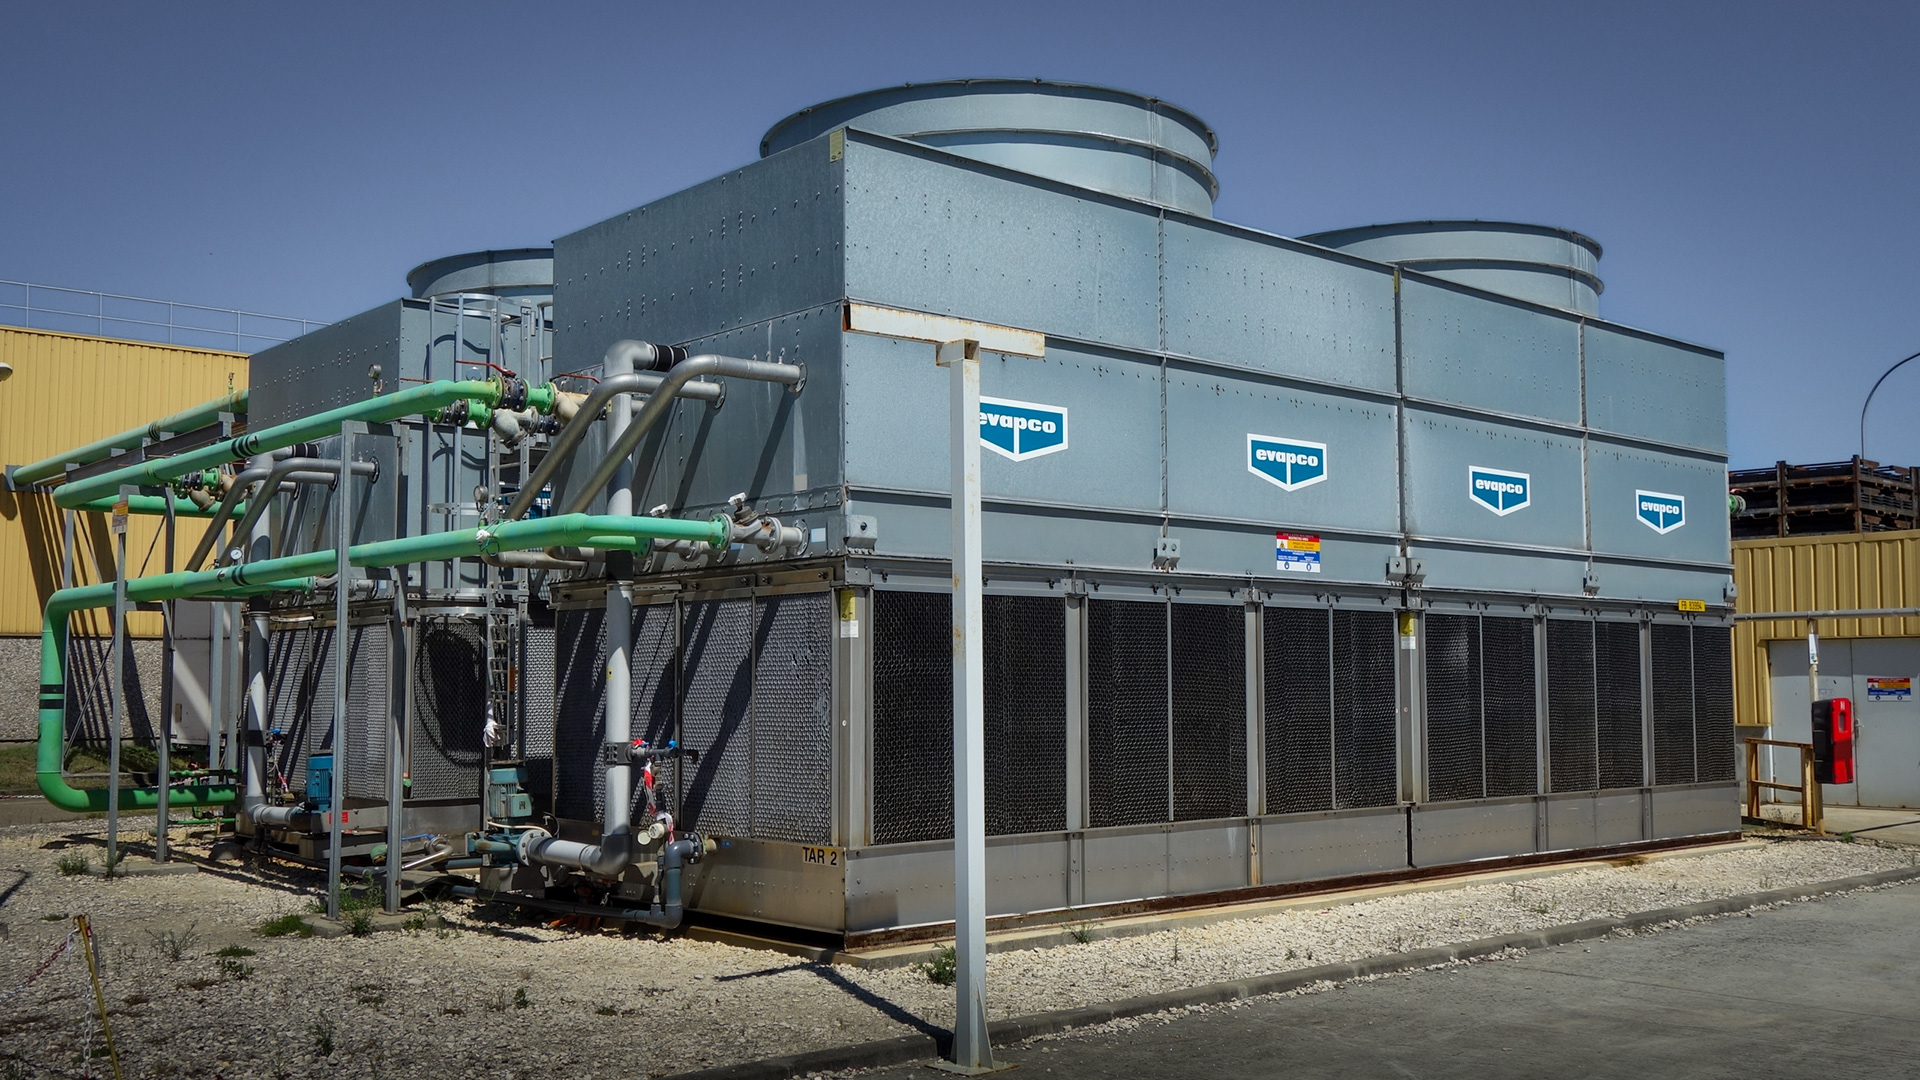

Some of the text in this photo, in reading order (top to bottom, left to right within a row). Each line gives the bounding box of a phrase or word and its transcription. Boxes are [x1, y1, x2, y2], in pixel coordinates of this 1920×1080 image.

[1256, 448, 1319, 470] evapco
[1475, 479, 1523, 497] evapco
[1641, 501, 1680, 517] evapco
[802, 846, 837, 866] TAR 2
